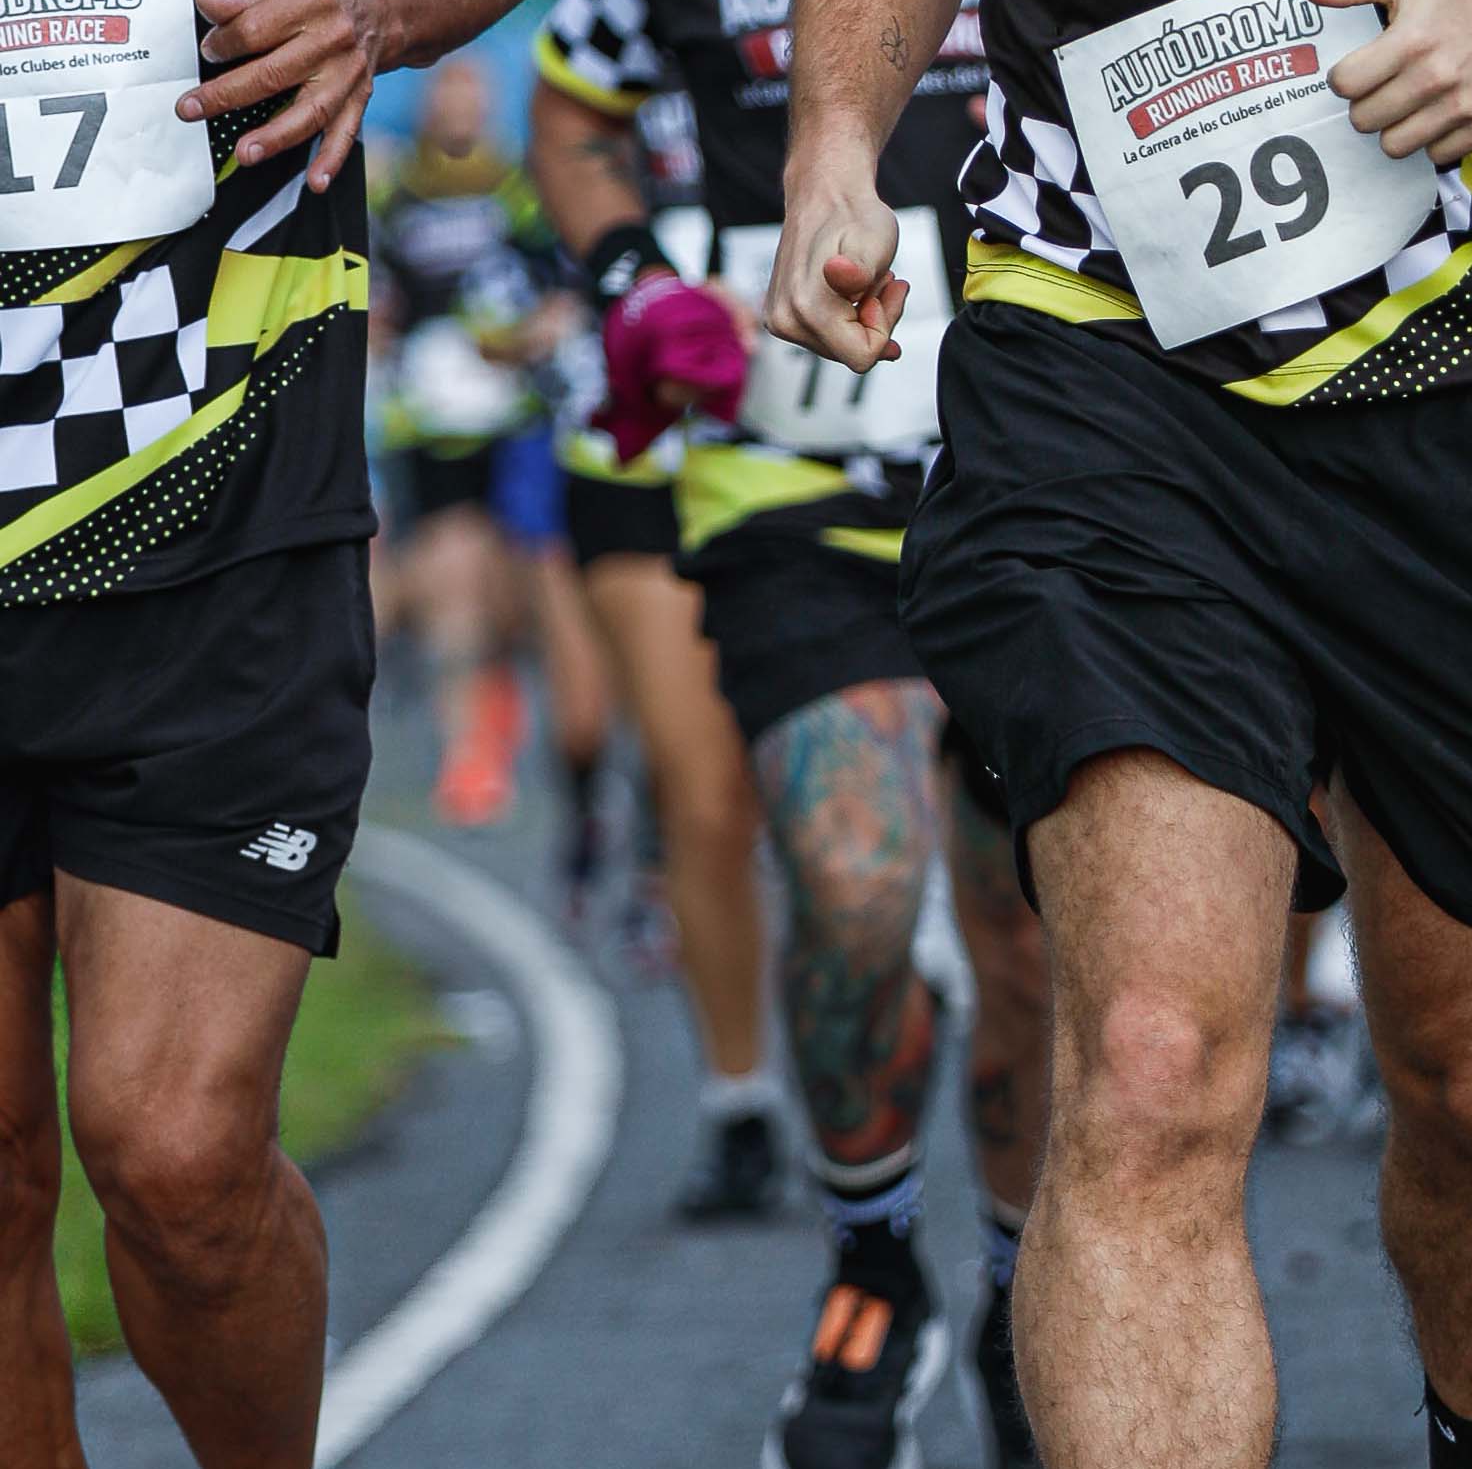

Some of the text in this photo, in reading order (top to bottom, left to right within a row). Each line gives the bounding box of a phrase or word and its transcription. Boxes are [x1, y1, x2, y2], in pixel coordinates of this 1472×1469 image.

[20, 59, 66, 74] Clubes
[69, 54, 90, 68] del
[92, 49, 151, 65] Noroeste
[49, 19, 106, 43] RACE
[1123, 80, 1330, 165] La Carrera de los Clubes del Noroe
[1145, 53, 1296, 129] RUNNING RACE
[0, 92, 108, 195] 17
[1179, 135, 1329, 268] 29
